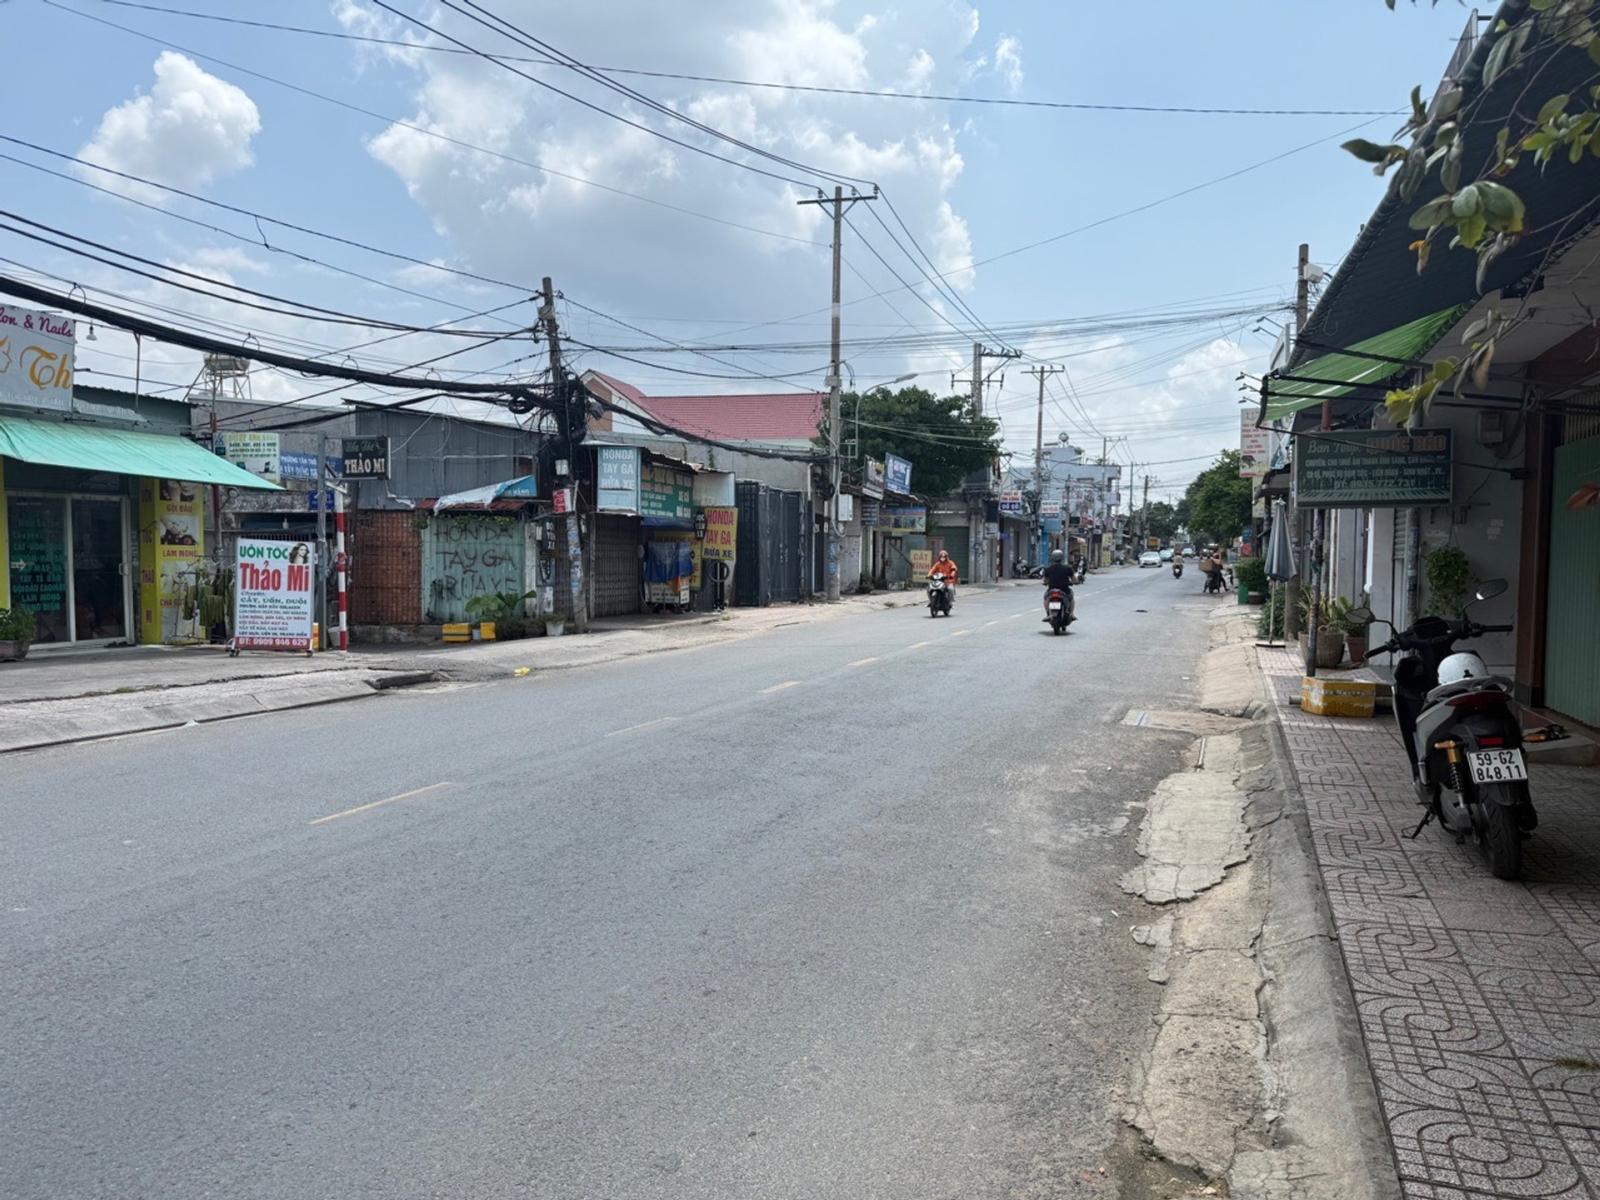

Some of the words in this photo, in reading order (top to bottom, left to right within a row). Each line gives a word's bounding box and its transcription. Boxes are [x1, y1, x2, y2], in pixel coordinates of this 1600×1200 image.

[39, 316, 74, 338] Nails
[602, 448, 634, 460] HONDA
[345, 452, 371, 474] THẢO
[373, 458, 385, 473] MI
[602, 462, 618, 474] TAY
[621, 463, 634, 474] GA
[707, 509, 734, 525] HONDA
[705, 529, 719, 544] TAY
[720, 530, 732, 545] GA
[239, 560, 282, 591] Thảo
[287, 564, 309, 592] Mi
[1476, 751, 1515, 766] 59-G2
[1476, 765, 1522, 781] 848.11
